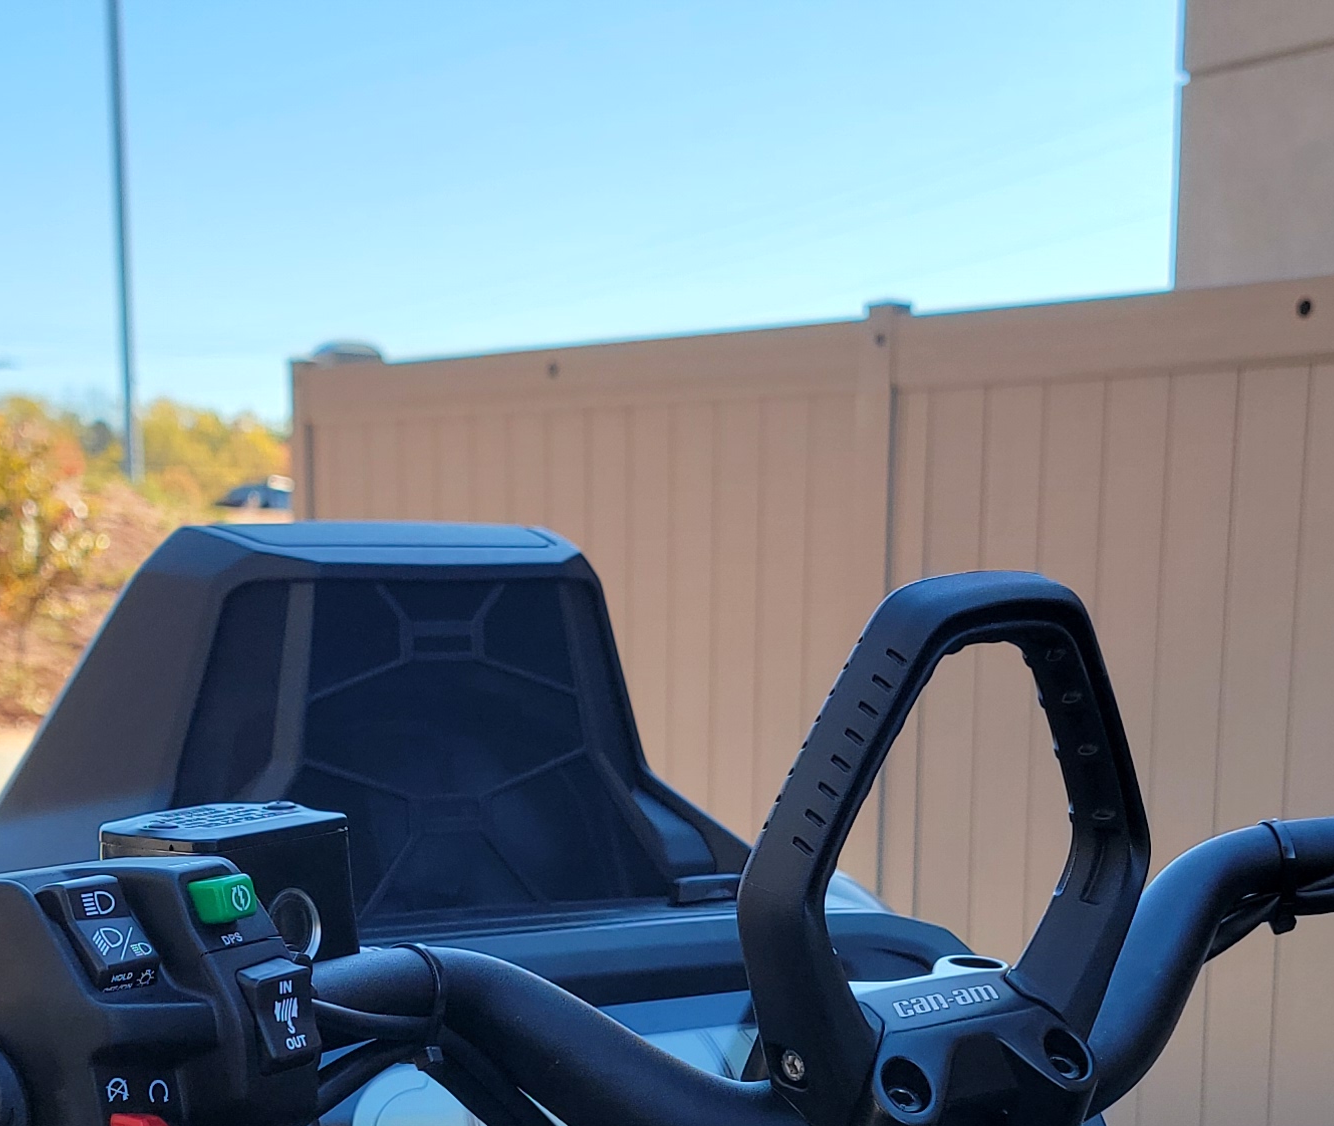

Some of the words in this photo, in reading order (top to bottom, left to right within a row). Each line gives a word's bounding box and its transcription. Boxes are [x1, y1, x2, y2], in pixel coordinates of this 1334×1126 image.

[221, 931, 243, 946] DPS
[279, 980, 293, 995] IN
[892, 984, 999, 1018] can-am
[285, 1034, 307, 1050] OUT
